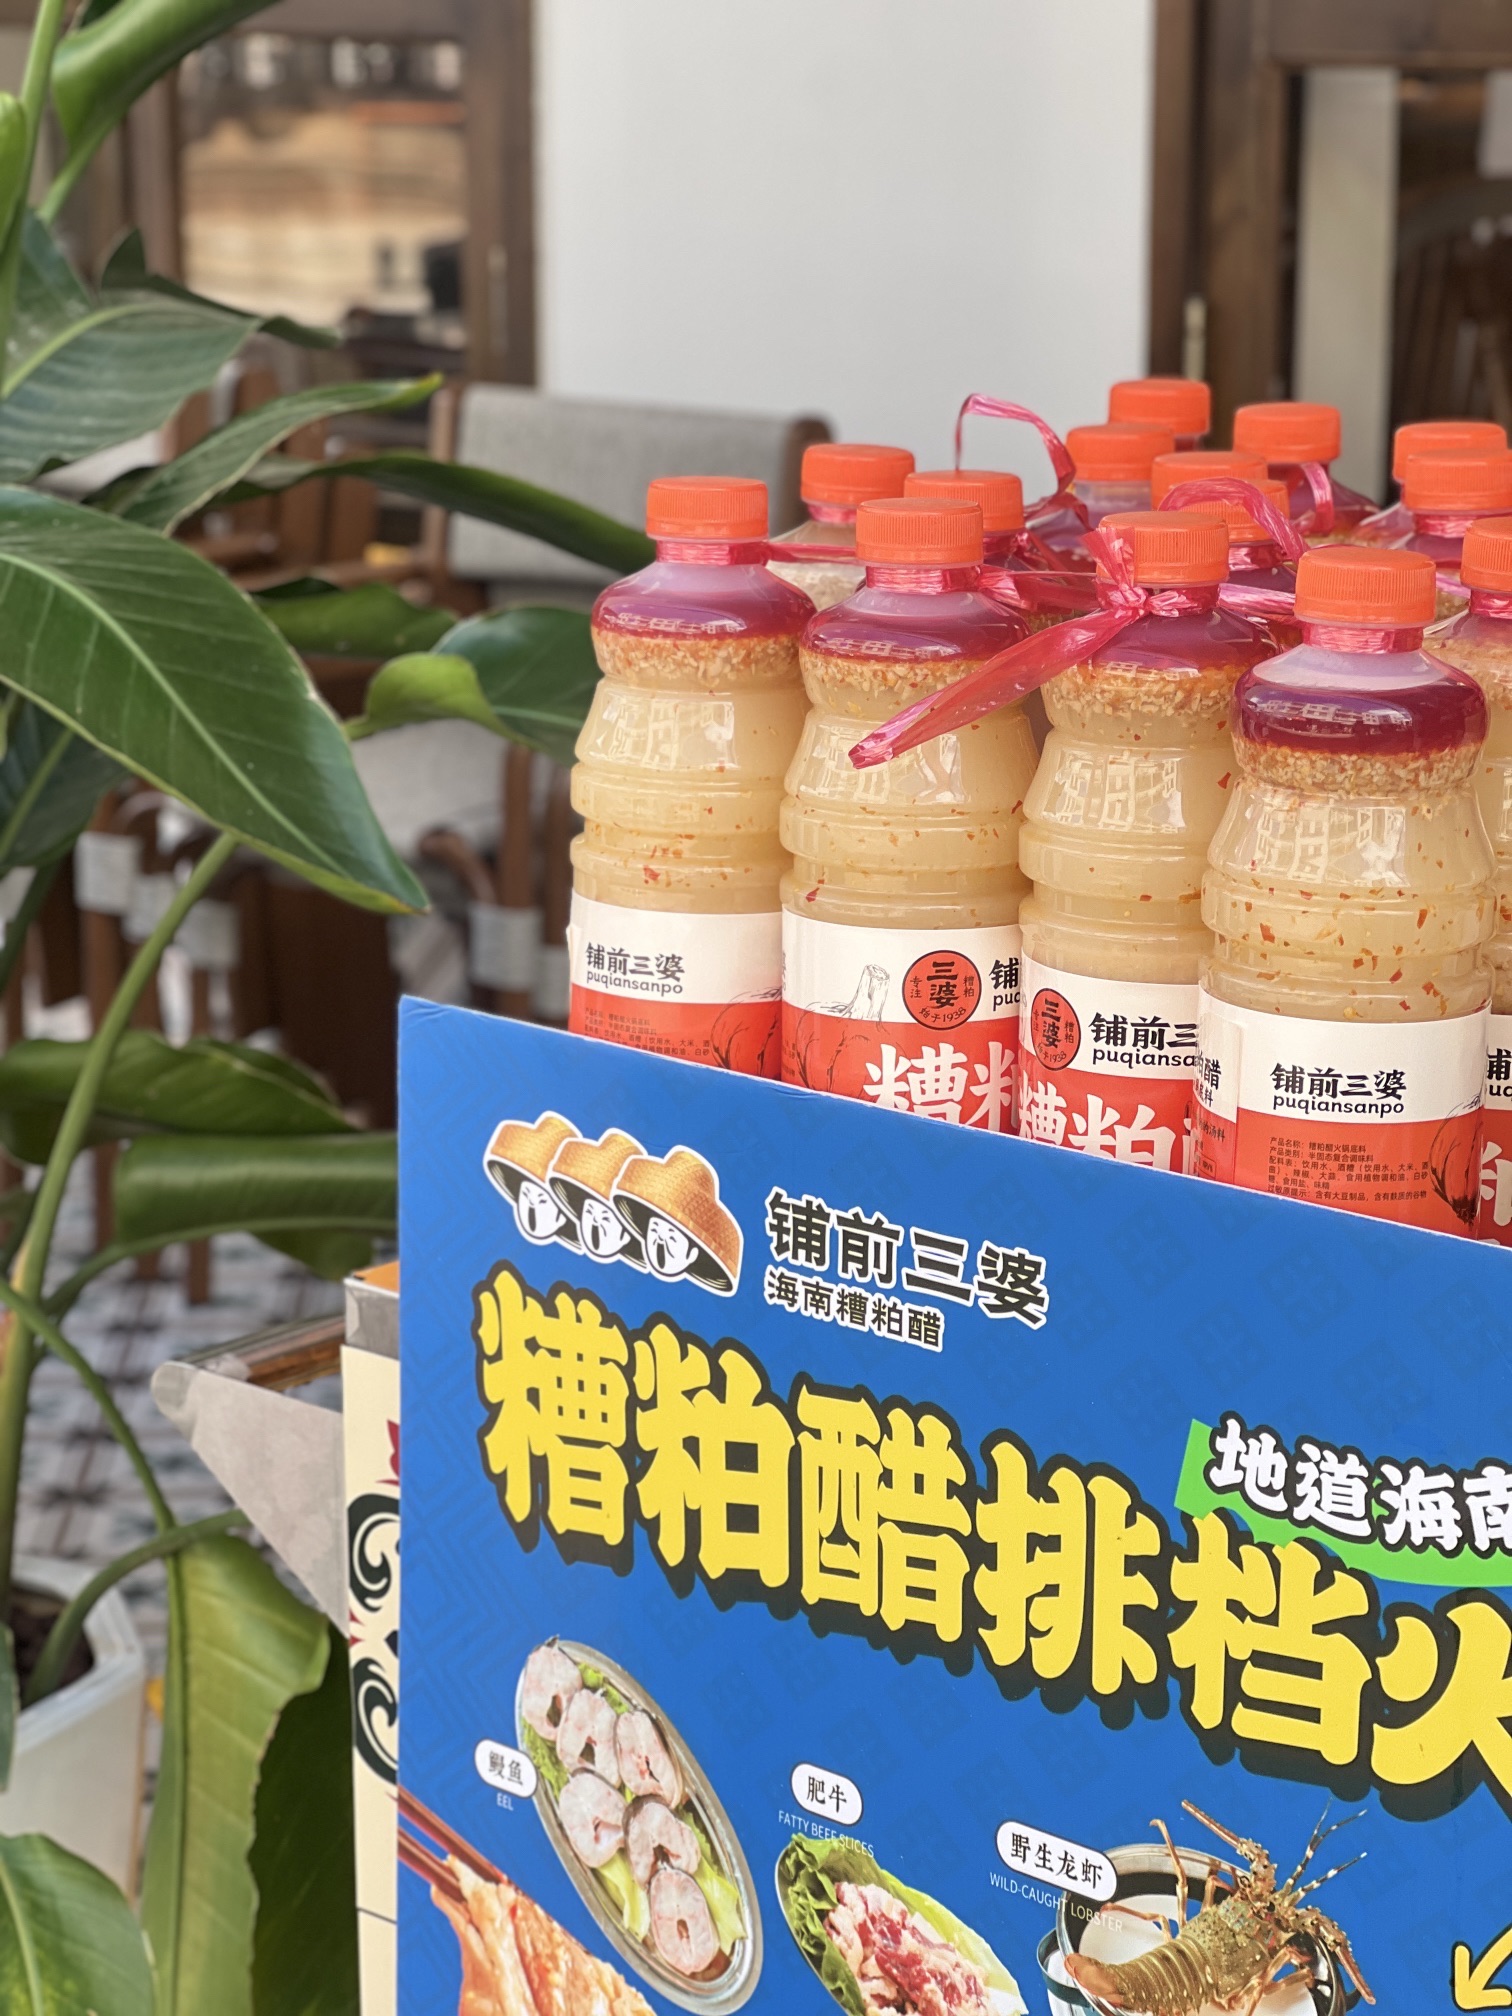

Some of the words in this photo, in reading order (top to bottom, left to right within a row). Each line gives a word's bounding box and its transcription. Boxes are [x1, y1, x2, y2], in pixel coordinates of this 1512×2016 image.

[585, 942, 685, 982] 铺前三婆
[586, 970, 683, 997] puqiansanpo
[909, 976, 922, 998] 专注
[926, 961, 960, 1009] 三婆
[963, 976, 975, 998] 糟粕
[919, 1007, 967, 1023] 始于1938
[1041, 998, 1062, 1049] 三婆
[1087, 1012, 1197, 1050] 铺前三
[1270, 1062, 1407, 1101] 铺前三婆
[1273, 1095, 1405, 1119] puqiansanpo
[766, 1189, 1048, 1327] 铺前三婆
[766, 1267, 943, 1350] 海南糟粕醋
[477, 1268, 1512, 1799] 糟粕醋排档火
[488, 1750, 523, 1786] 鳗鱼
[496, 1792, 514, 1811] EEL
[806, 1775, 847, 1813] 肥牛
[778, 1810, 809, 1833] FATTY
[811, 1822, 837, 1841] BEEF
[838, 1833, 875, 1858] SLICES
[1010, 1832, 1102, 1889] 野生龙虾
[989, 1871, 1068, 1912] WILD-CAUGHT
[1070, 1902, 1123, 1933] LOBSTER
